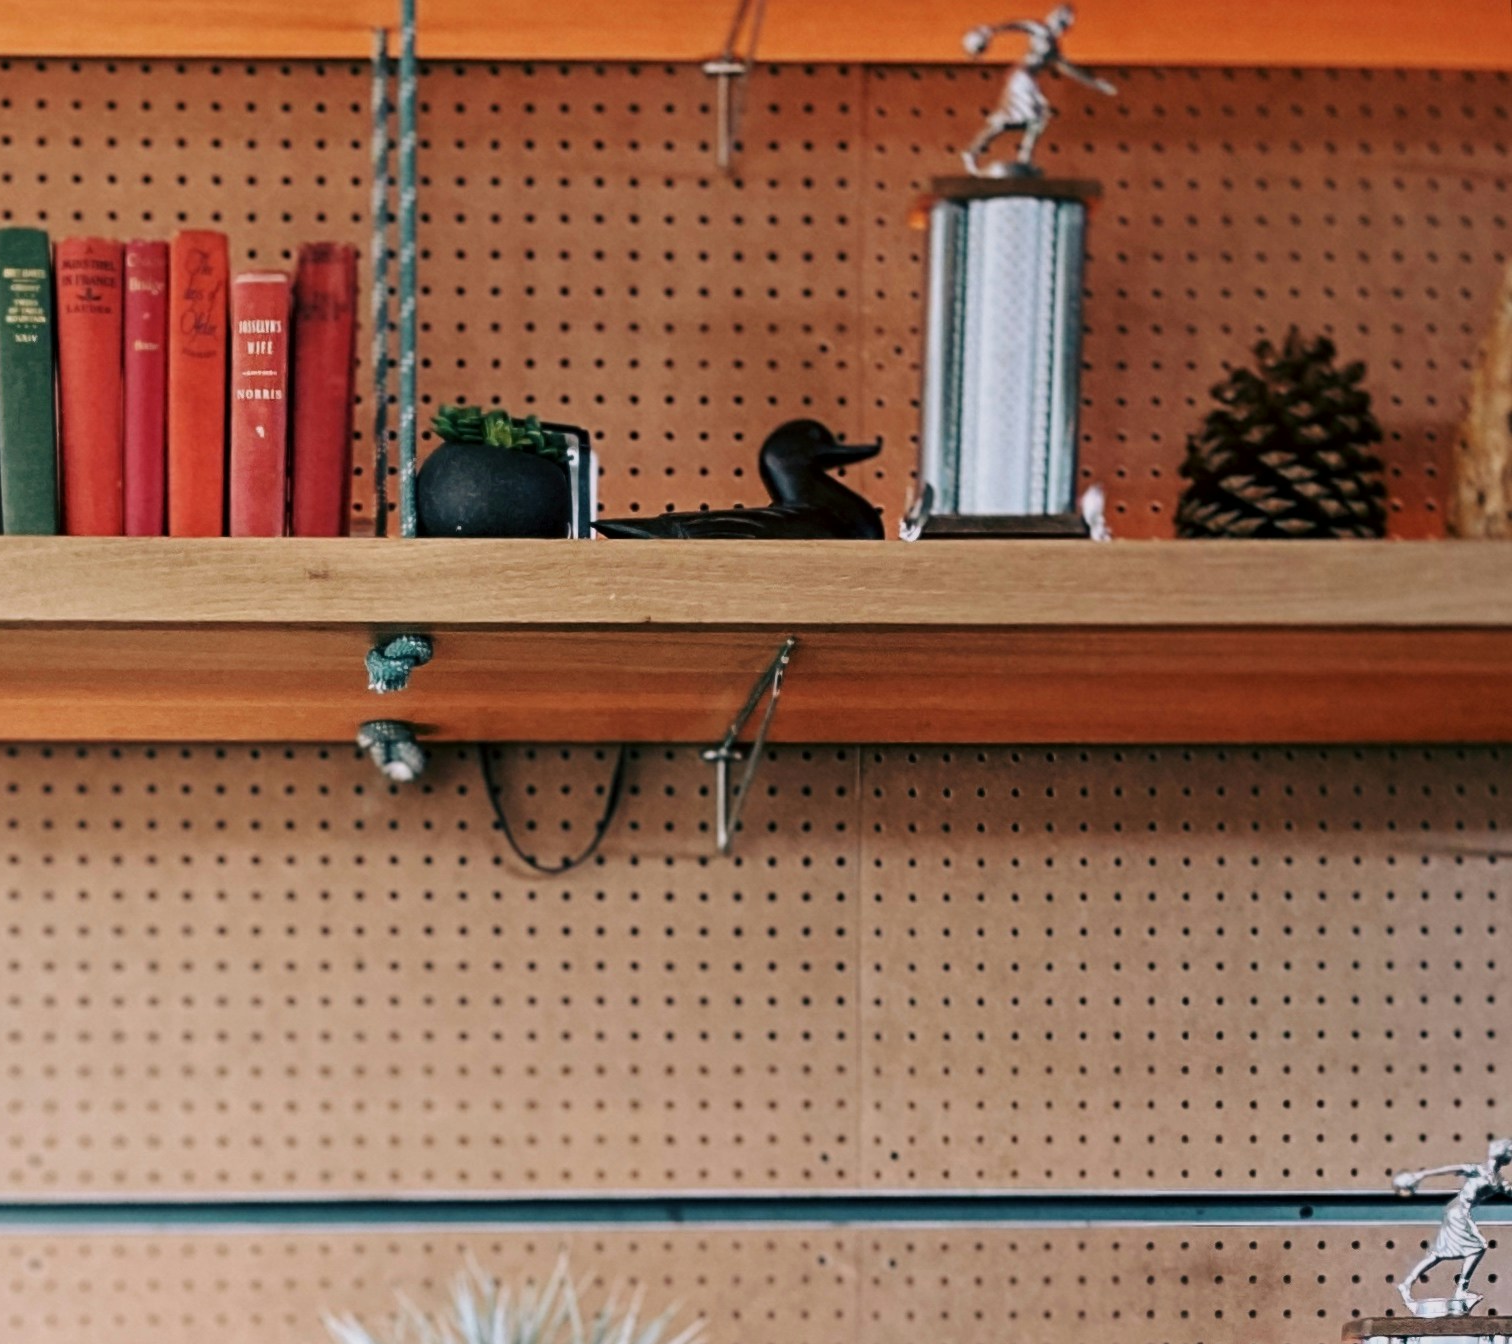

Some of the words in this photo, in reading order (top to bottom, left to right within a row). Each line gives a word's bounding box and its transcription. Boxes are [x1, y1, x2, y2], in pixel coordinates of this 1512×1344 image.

[76, 275, 117, 288] FRANCE
[238, 320, 283, 334] JOSSELYN'S
[246, 341, 274, 355] WIFE
[237, 389, 283, 400] NORRIS
